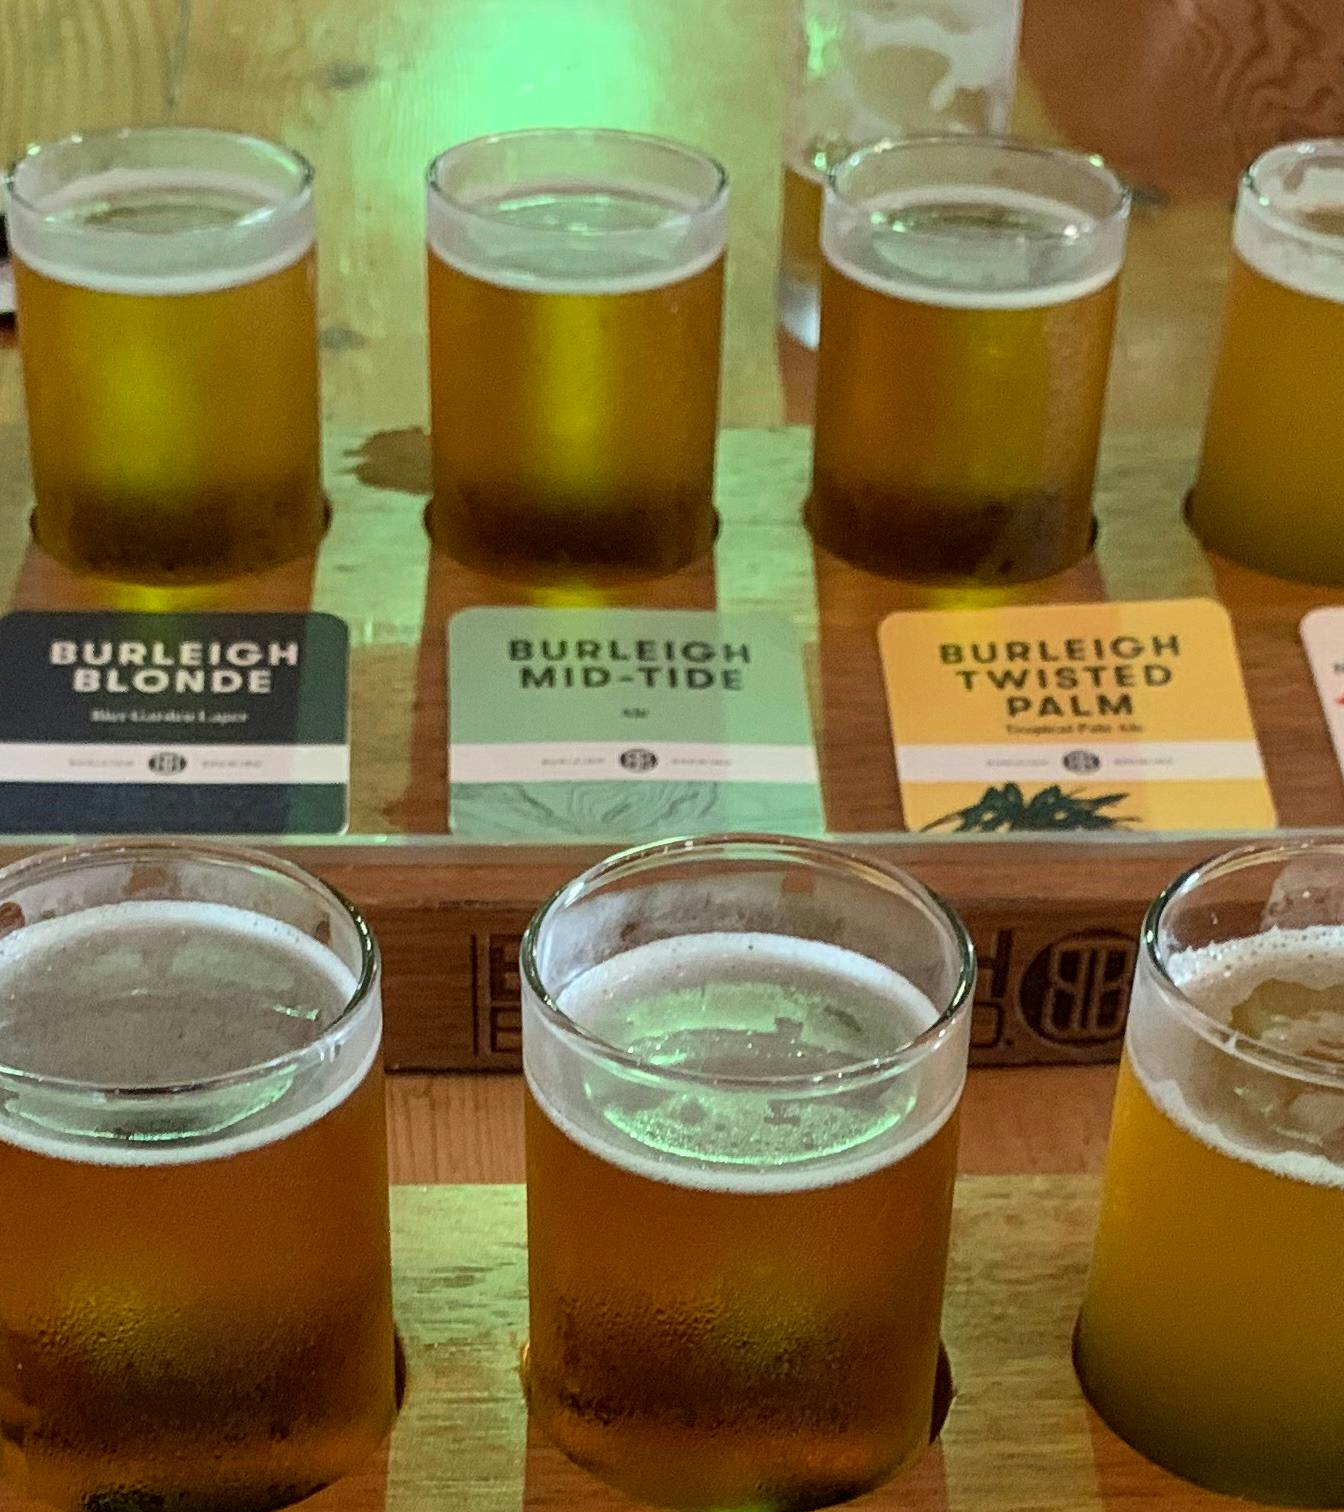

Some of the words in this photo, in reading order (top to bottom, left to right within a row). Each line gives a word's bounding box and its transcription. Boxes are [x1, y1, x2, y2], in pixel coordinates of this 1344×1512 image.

[49, 640, 299, 667] BURLEIGH
[509, 638, 751, 664] BURLEIGH
[939, 635, 1181, 665] BURLEIGH
[72, 668, 273, 694] BLONDE
[519, 666, 743, 690] MID-TIDE
[956, 664, 1173, 692] TWISTED
[1007, 694, 1134, 718] PALM
